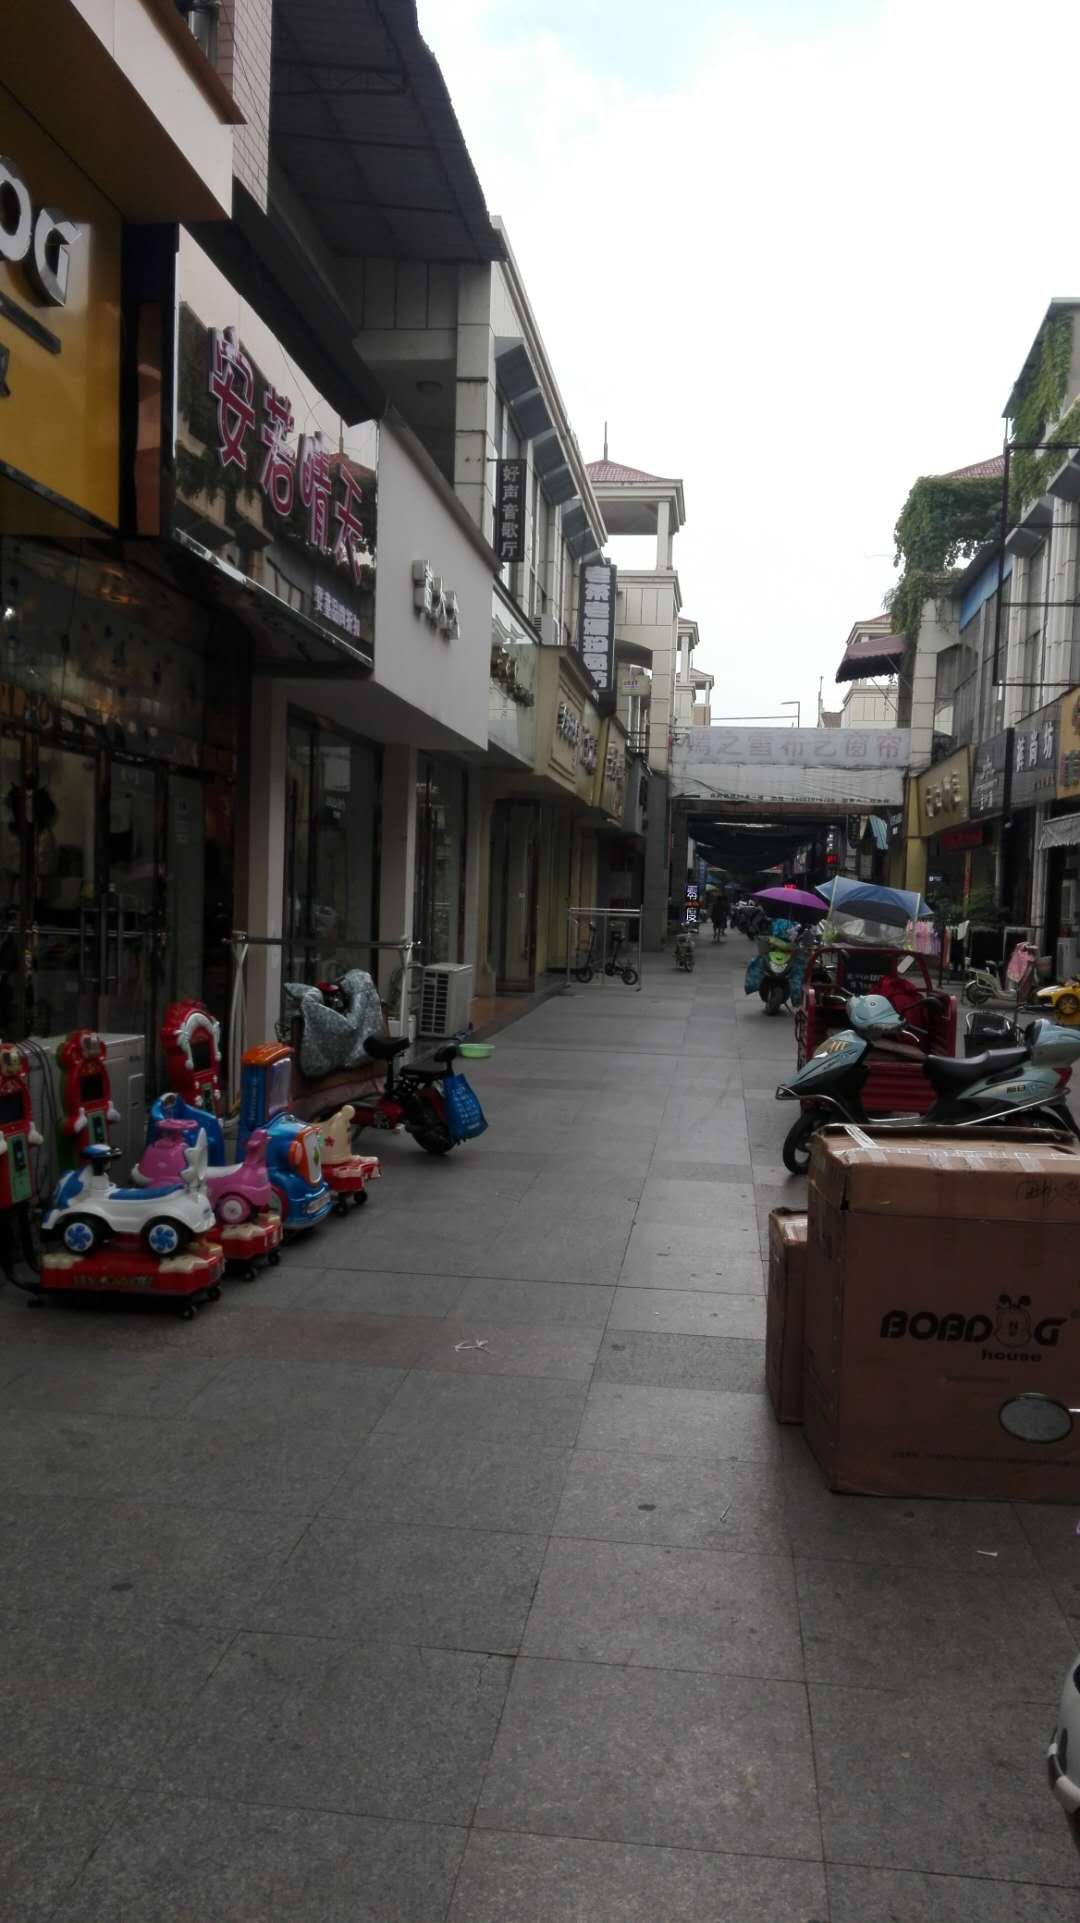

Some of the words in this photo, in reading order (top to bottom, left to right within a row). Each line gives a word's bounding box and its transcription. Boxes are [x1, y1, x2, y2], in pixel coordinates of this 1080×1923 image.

[501, 464, 521, 559] 好声音歌厅
[981, 1348, 1043, 1363] house
